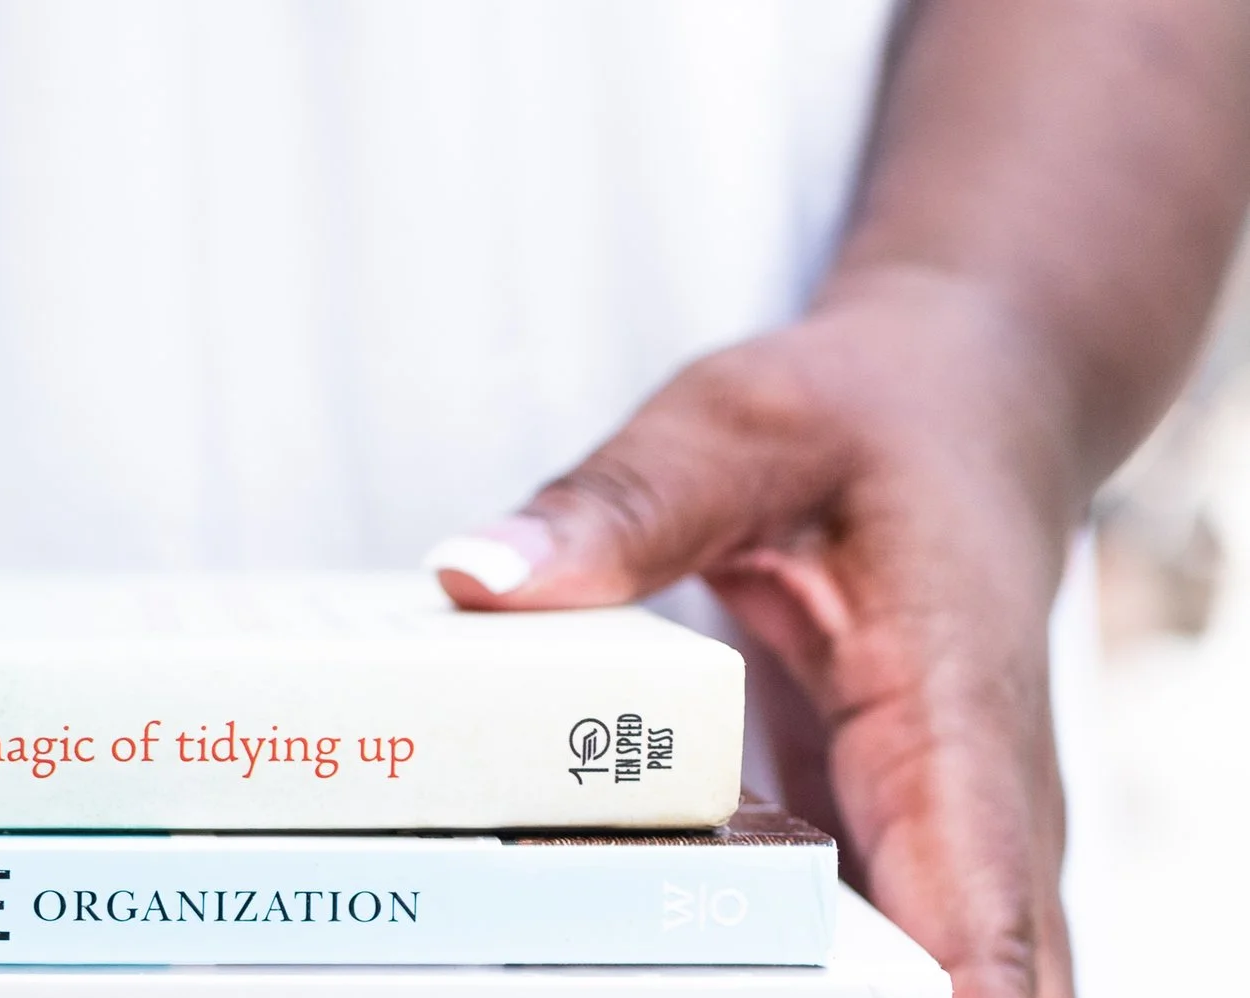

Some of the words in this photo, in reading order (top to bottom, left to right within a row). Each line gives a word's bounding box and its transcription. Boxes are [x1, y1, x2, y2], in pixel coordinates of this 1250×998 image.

[110, 719, 162, 763] of
[174, 719, 342, 780] tidying
[357, 735, 415, 779] up
[616, 713, 643, 755] SPEED
[646, 728, 674, 770] PRESS
[614, 758, 641, 784] TEN
[33, 889, 421, 923] ORGANIZATION
